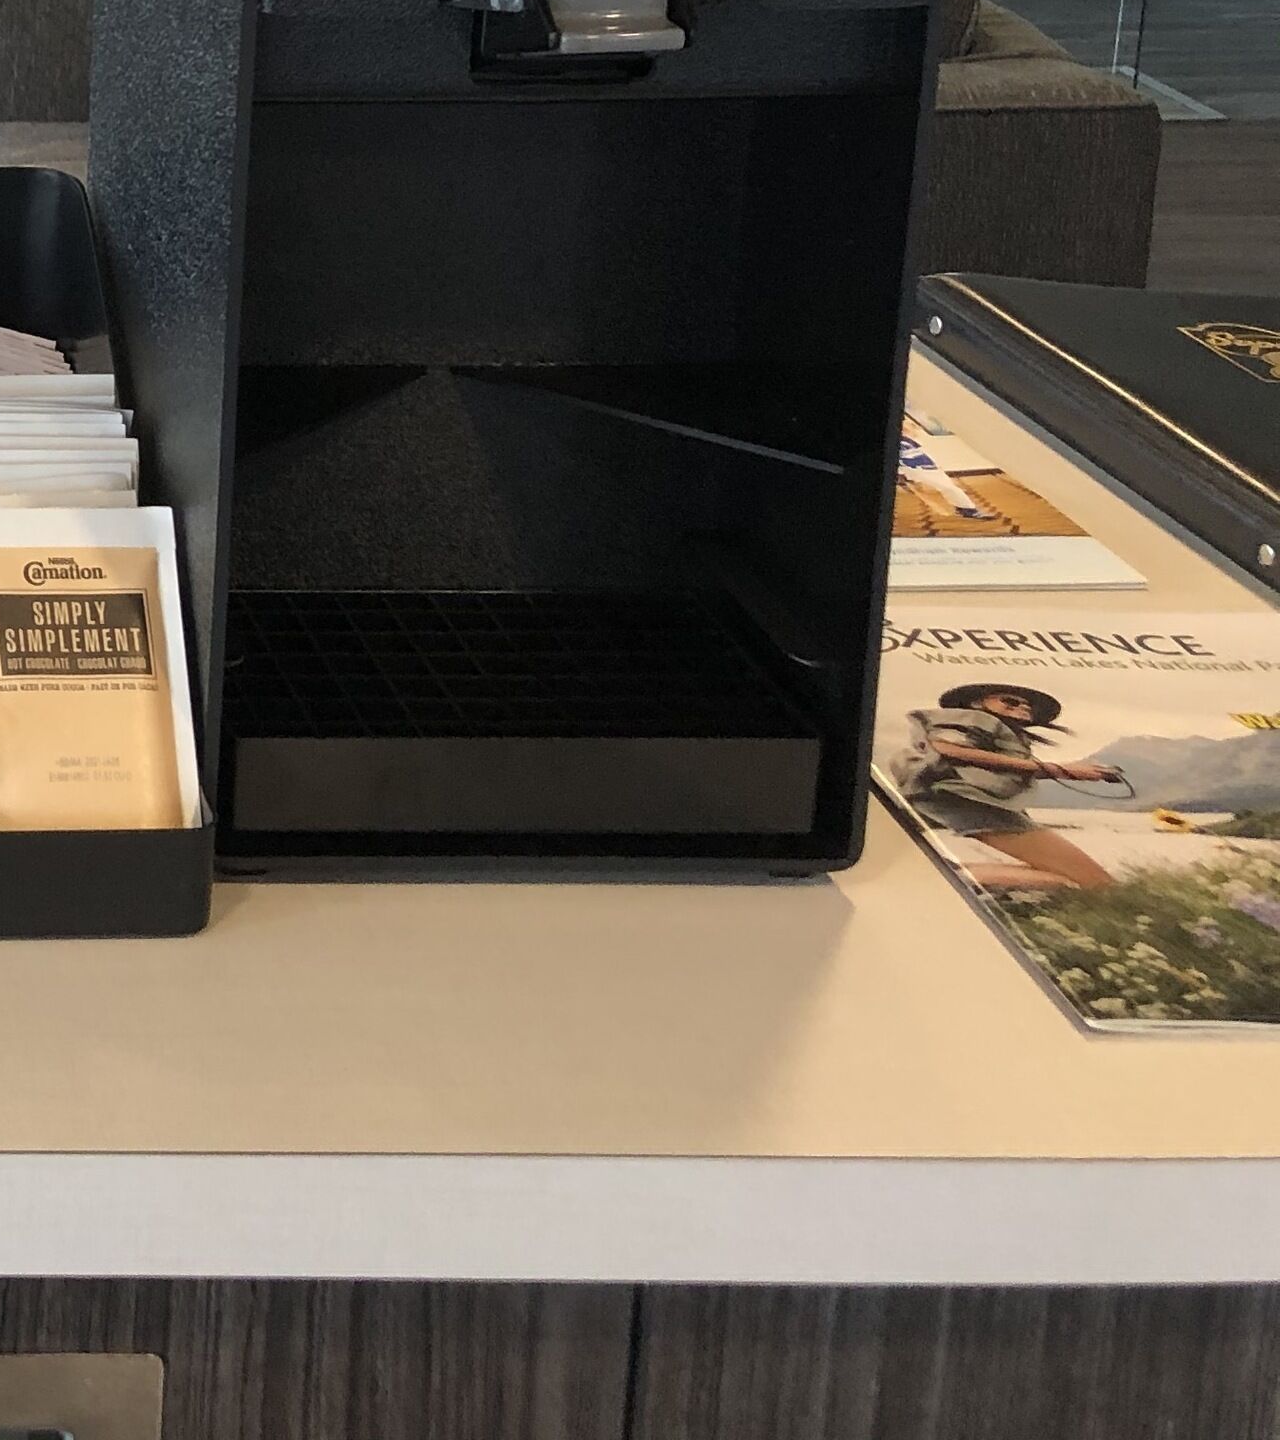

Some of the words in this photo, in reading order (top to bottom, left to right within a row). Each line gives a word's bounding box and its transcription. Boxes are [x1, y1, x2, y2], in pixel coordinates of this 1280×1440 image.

[32, 601, 106, 626] SIMPLY
[5, 627, 141, 654] SIMPLEMENT
[912, 652, 1048, 667] Waterton
[1051, 656, 1129, 669] Lakes
[1131, 658, 1253, 671] National
